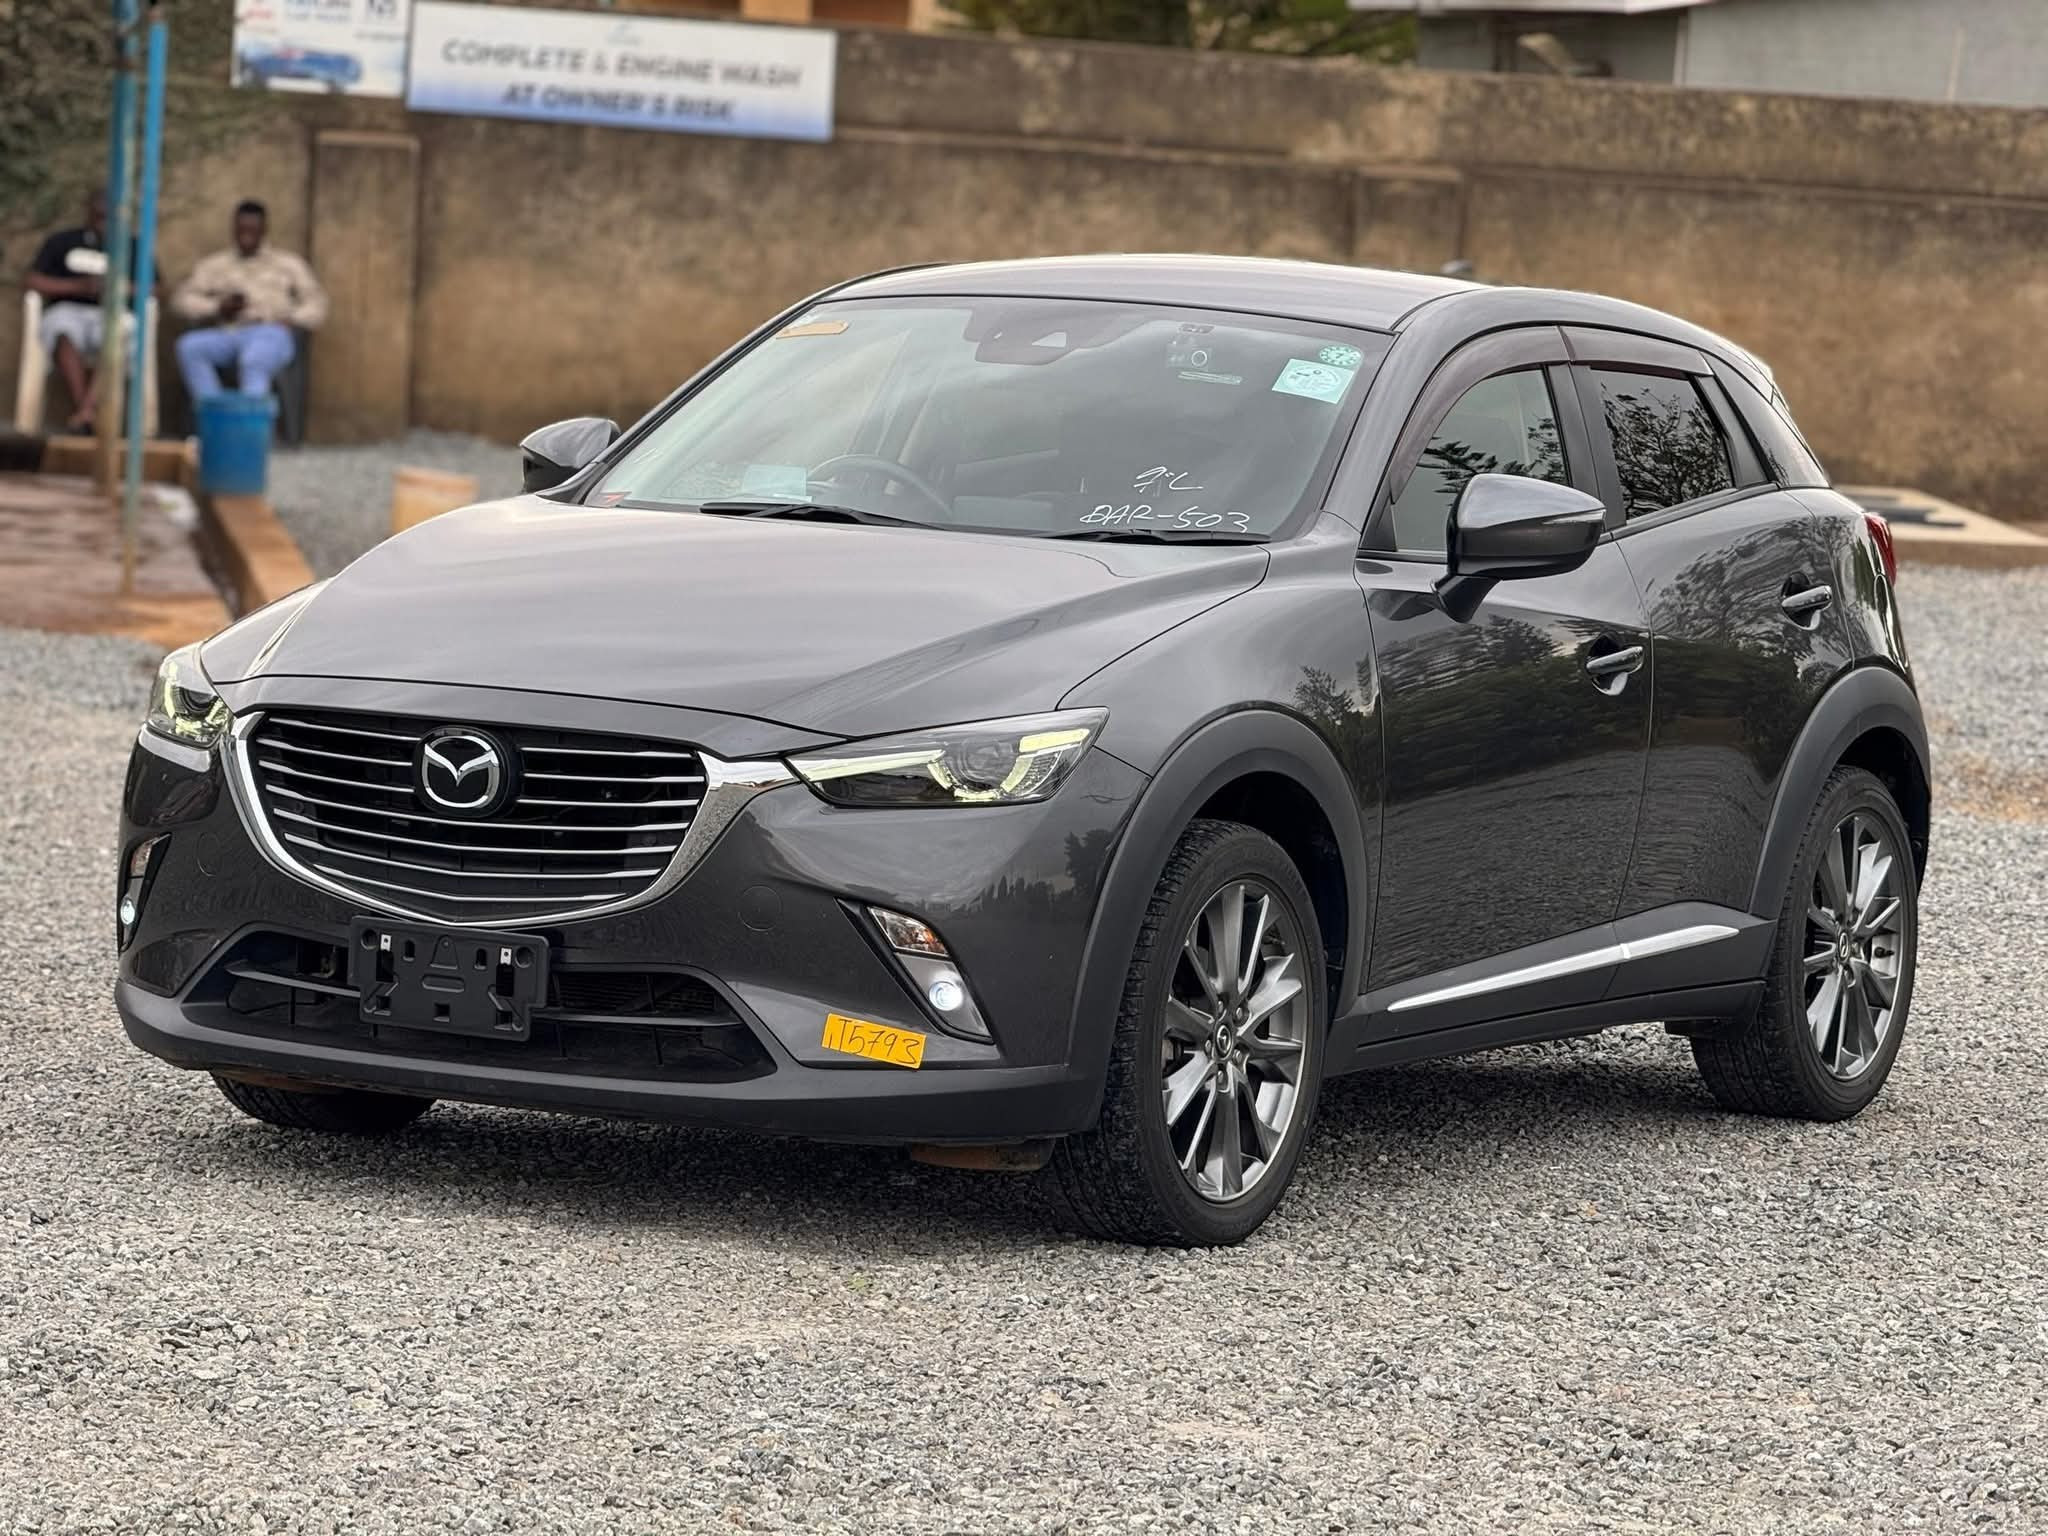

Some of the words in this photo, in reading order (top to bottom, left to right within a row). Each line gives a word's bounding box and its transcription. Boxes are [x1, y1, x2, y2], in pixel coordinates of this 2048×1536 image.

[442, 37, 586, 71] COMPLETE
[616, 54, 713, 83] ENGINE
[719, 62, 804, 88] WASH
[502, 82, 538, 105] AT
[542, 84, 668, 117] OWNER'S
[673, 94, 735, 121] RISK
